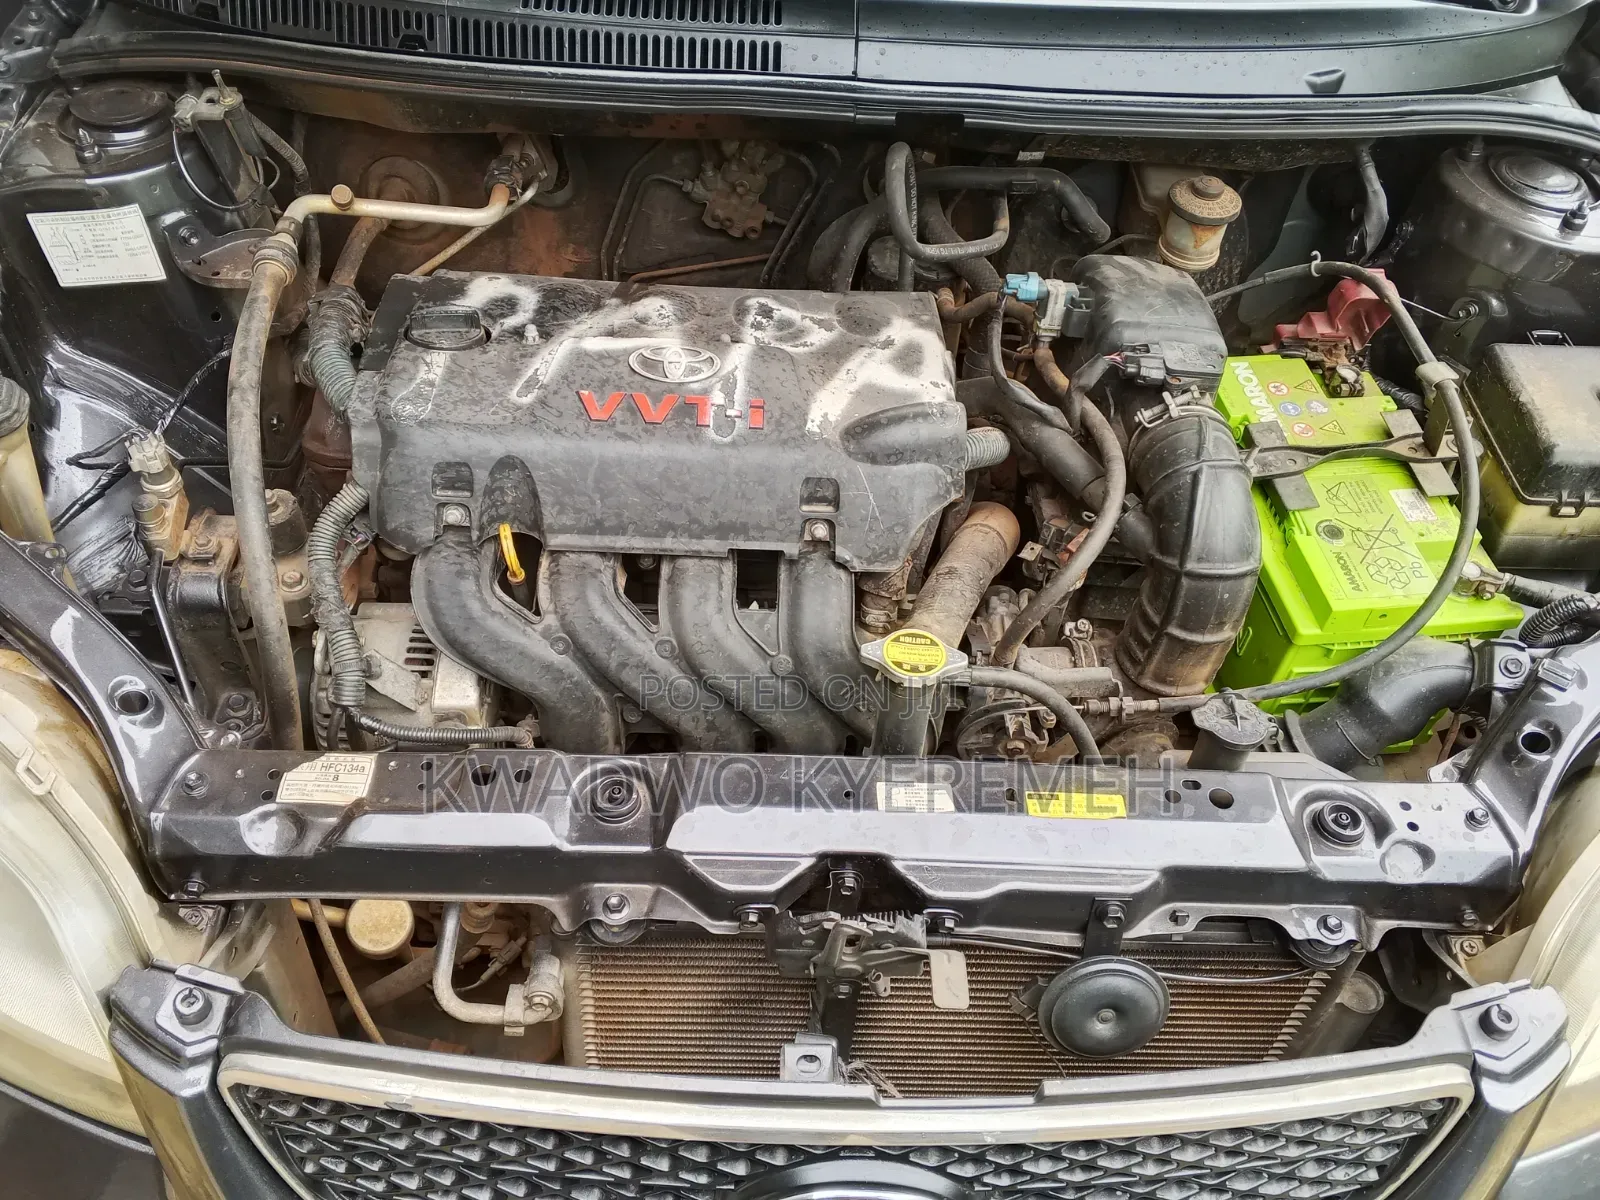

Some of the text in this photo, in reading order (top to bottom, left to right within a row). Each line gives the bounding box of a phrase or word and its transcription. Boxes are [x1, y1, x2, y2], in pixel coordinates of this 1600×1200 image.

[1230, 361, 1287, 436] MARON
[1332, 551, 1363, 592] AMARON
[1409, 561, 1428, 578] Pb
[900, 636, 931, 644] CAUTION
[320, 762, 365, 773] HFC134a
[332, 774, 339, 782] 8
